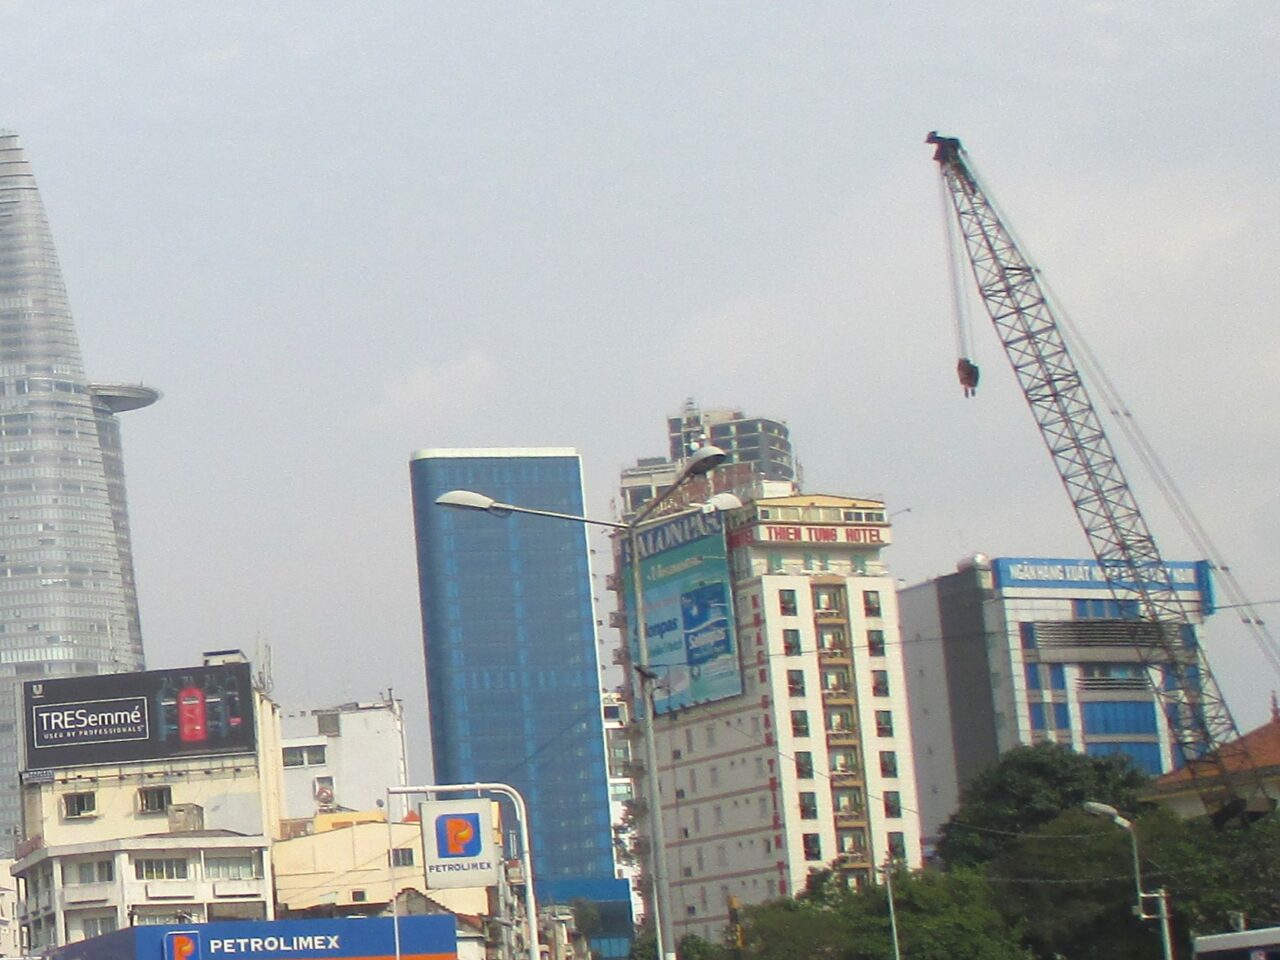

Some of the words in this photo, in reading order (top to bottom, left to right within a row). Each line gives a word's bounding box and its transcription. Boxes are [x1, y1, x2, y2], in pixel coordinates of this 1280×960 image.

[845, 528, 885, 544] HOTEL
[39, 705, 141, 731] TRESemmé
[428, 862, 493, 873] PETROLIMEX
[209, 934, 340, 954] PETROLIMEX
